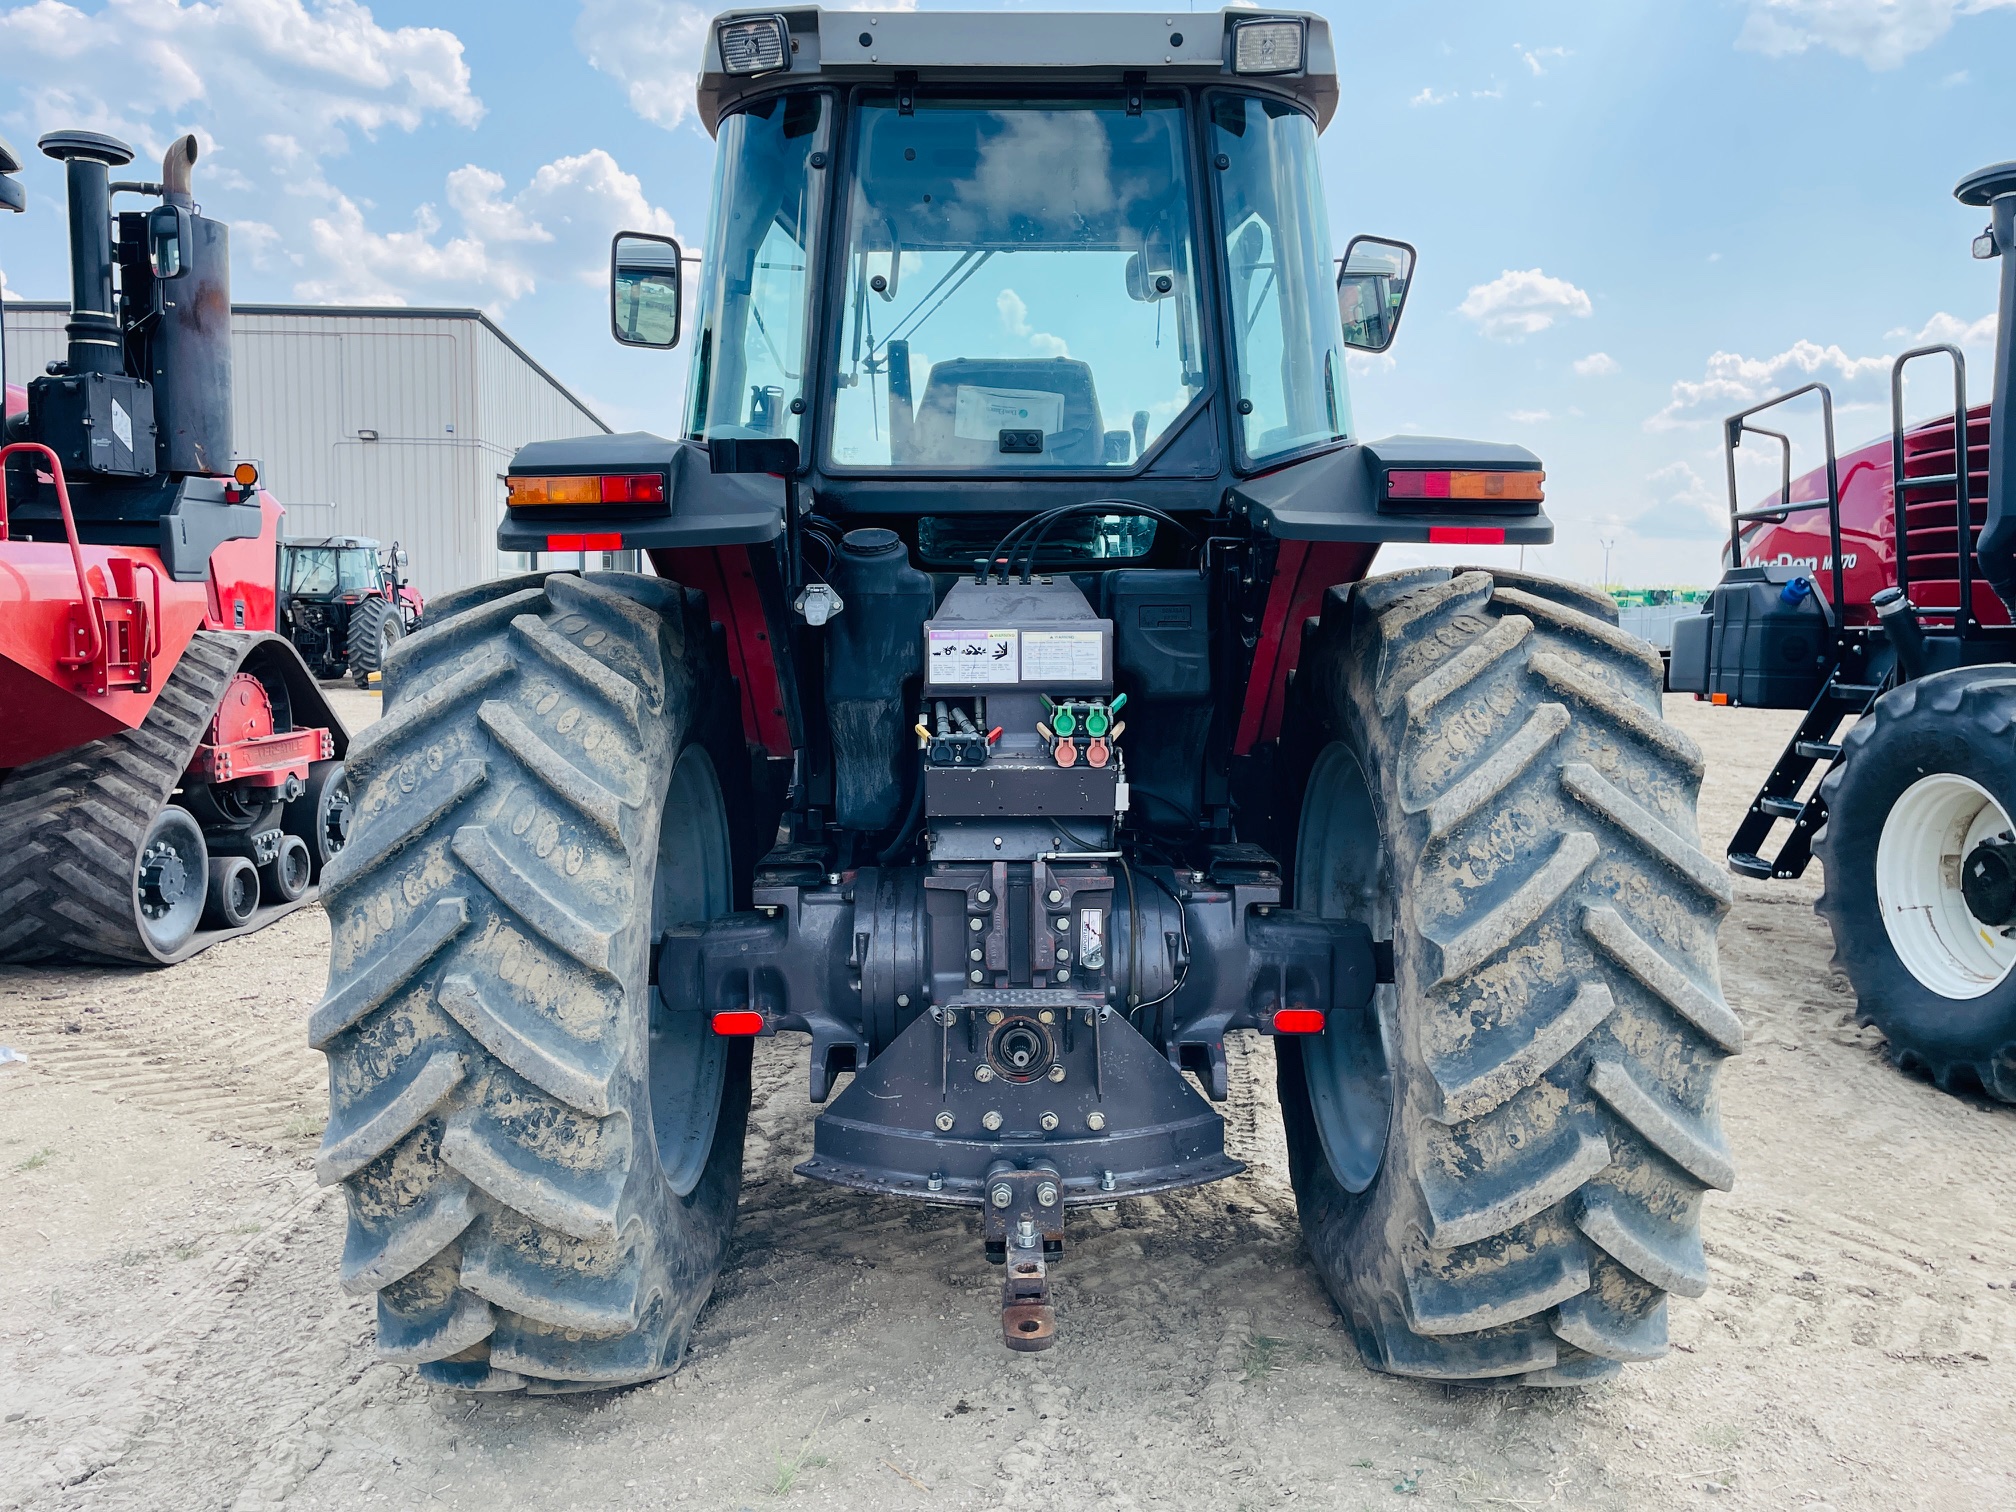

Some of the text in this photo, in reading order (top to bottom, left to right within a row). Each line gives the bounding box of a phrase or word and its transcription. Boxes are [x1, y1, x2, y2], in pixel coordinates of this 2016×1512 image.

[1745, 553, 1857, 571] MacDon M70
[255, 739, 303, 758] VERSATILE
